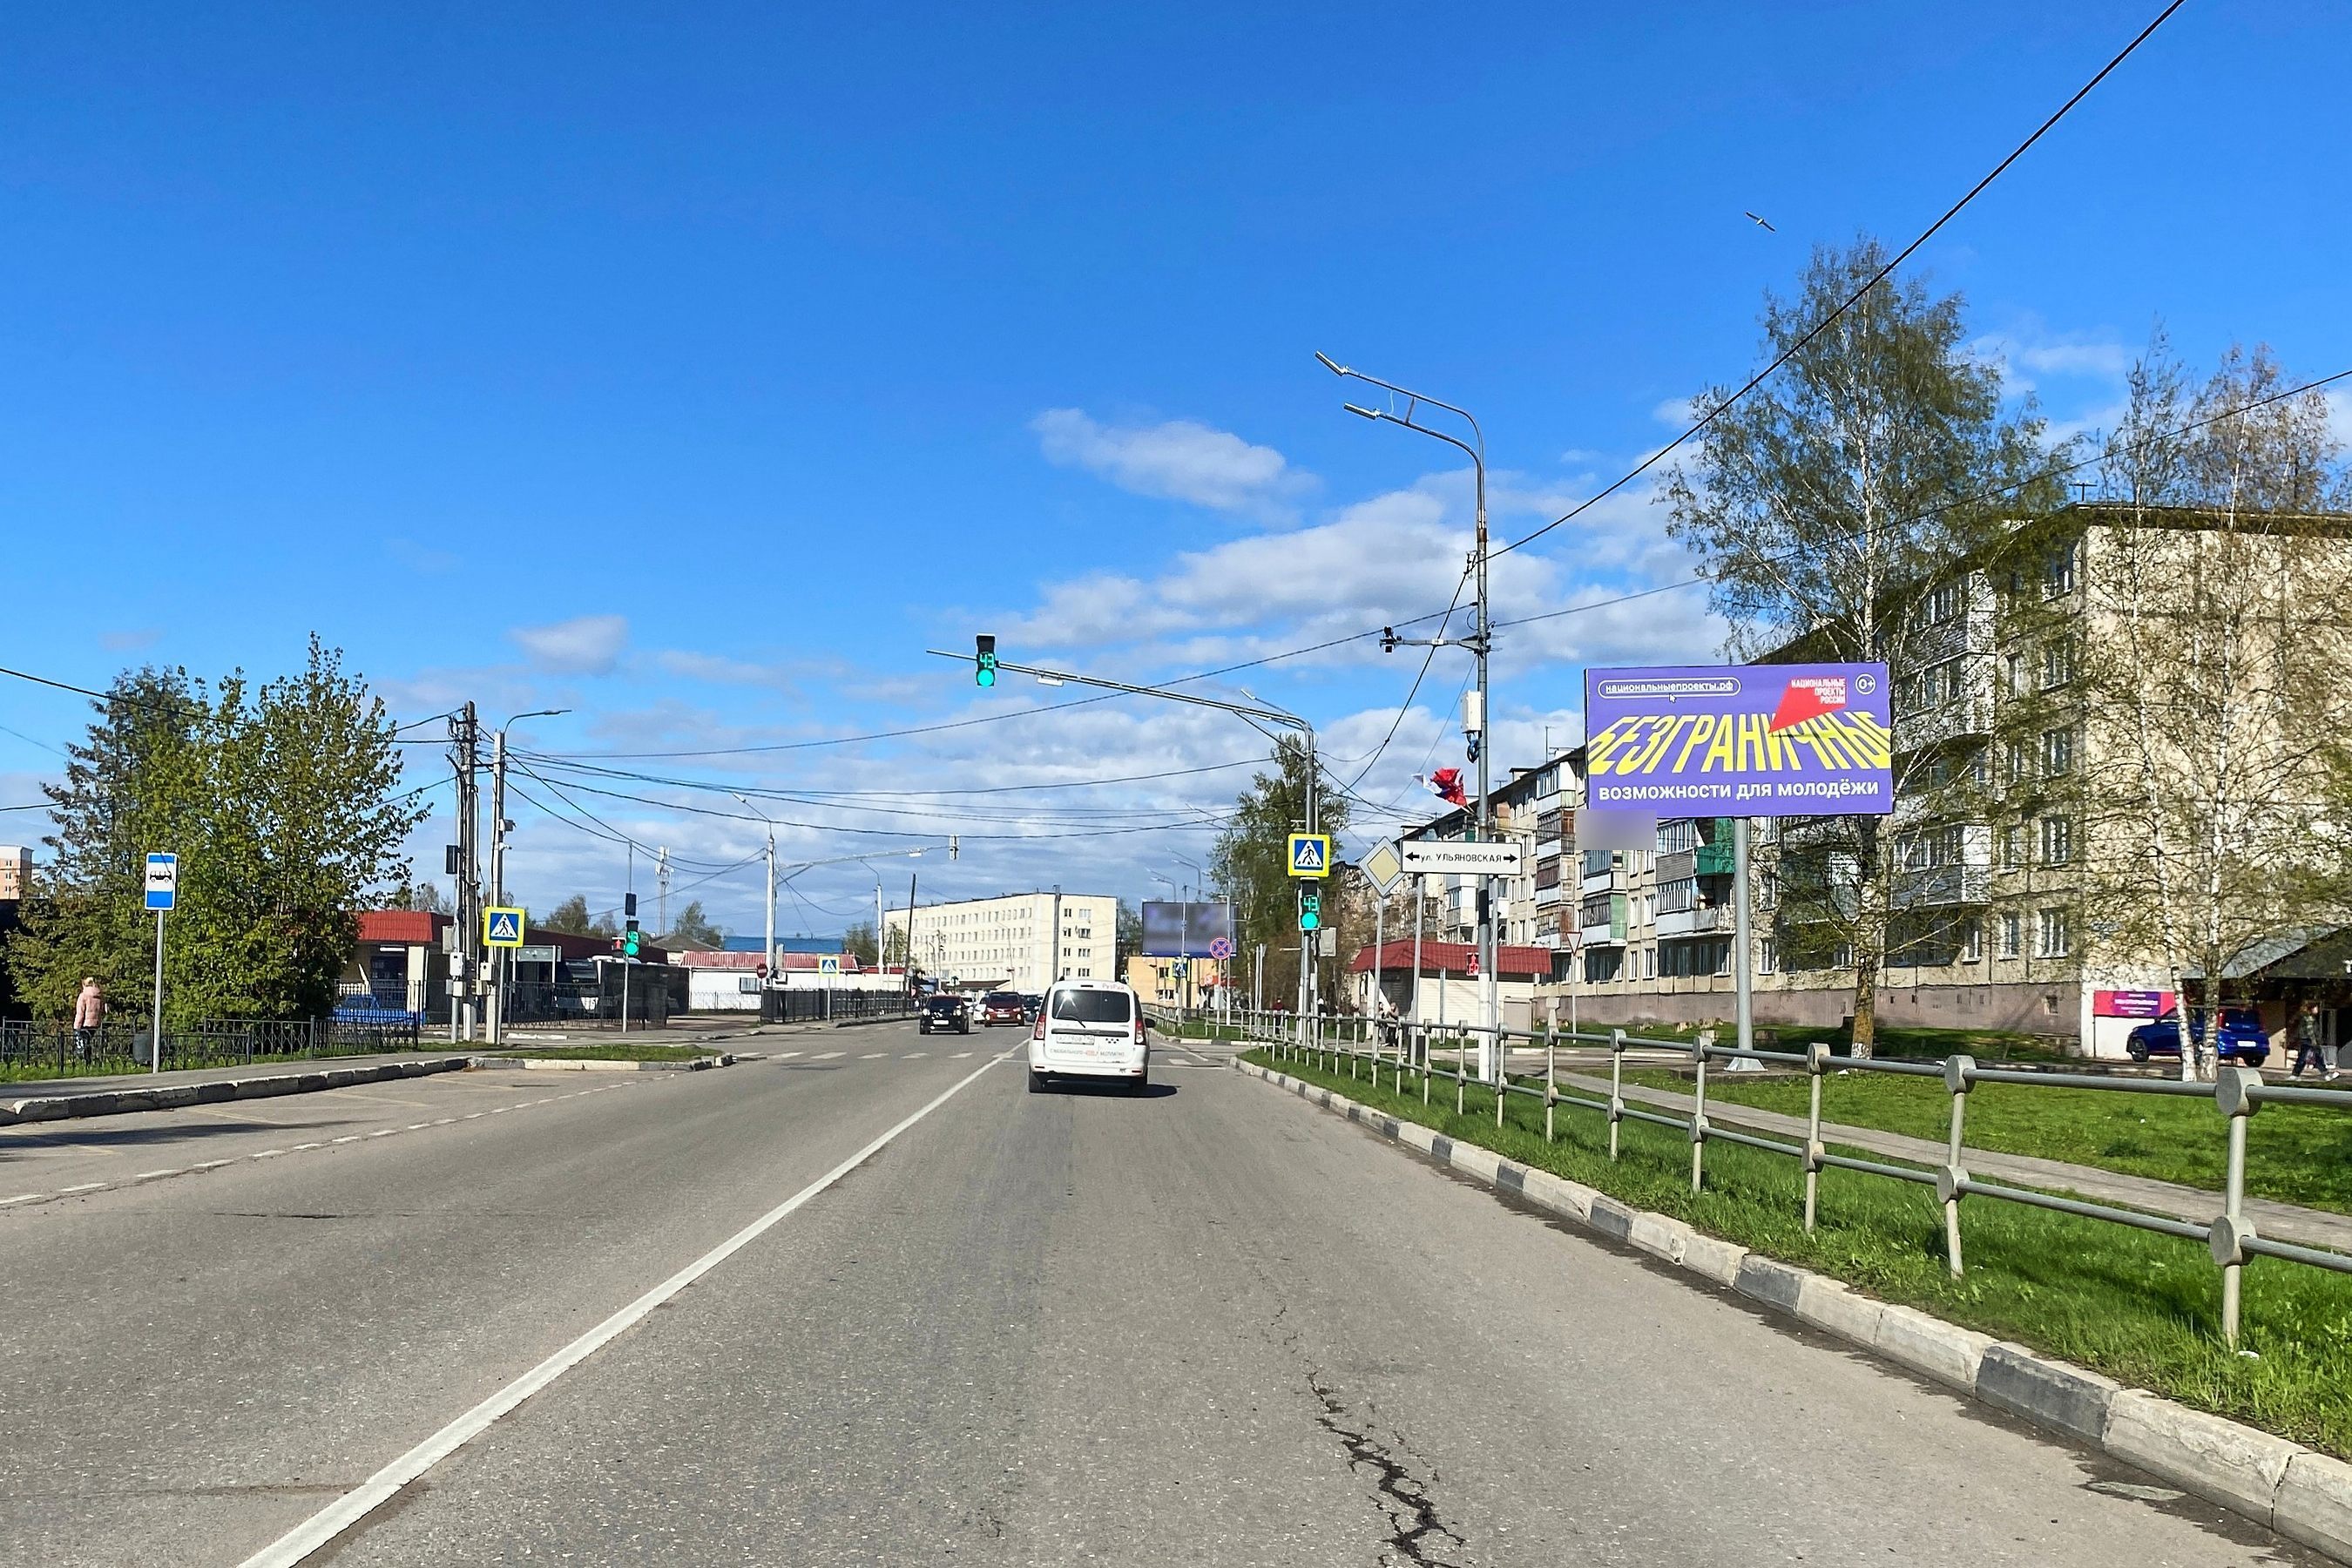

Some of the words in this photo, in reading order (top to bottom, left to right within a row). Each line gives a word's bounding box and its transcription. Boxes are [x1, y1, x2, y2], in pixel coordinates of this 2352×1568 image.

[980, 653, 994, 669] 43
[1791, 678, 1846, 688] НАЦИОНАЛЬНЫЕ
[1858, 678, 1875, 690] 0+
[1815, 687, 1846, 696] ПРОЕКТЫ
[1821, 696, 1846, 705] РОССИИ
[1598, 785, 1732, 801] возможности
[1736, 784, 1772, 801] для
[1778, 779, 1879, 799] молодёжи
[1420, 855, 1433, 863] ул.
[1436, 853, 1502, 863] УЛЬЯНОВСКАЯ
[1303, 896, 1319, 912] 43
